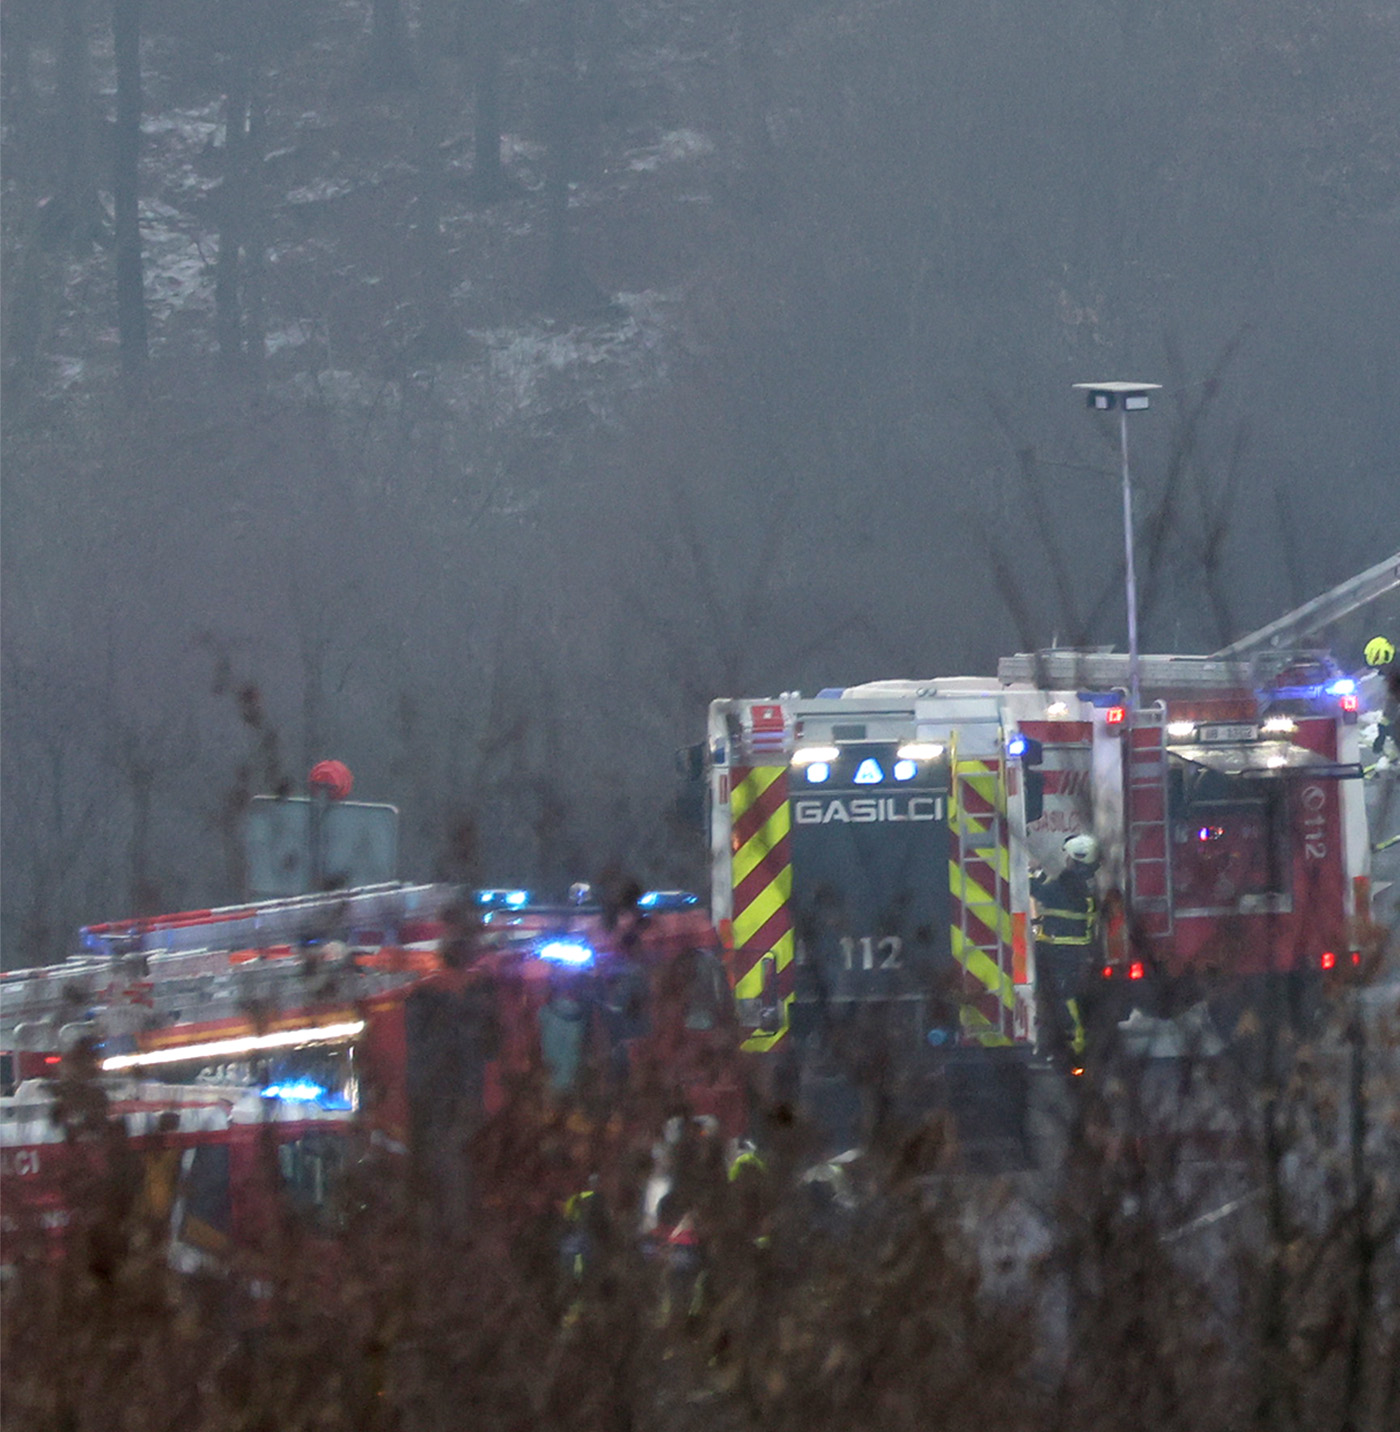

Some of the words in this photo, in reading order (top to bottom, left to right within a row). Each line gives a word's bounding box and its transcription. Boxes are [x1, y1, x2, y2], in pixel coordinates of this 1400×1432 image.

[795, 797, 943, 824] GASILCI
[1304, 816, 1328, 860] 112
[839, 936, 902, 970] 112
